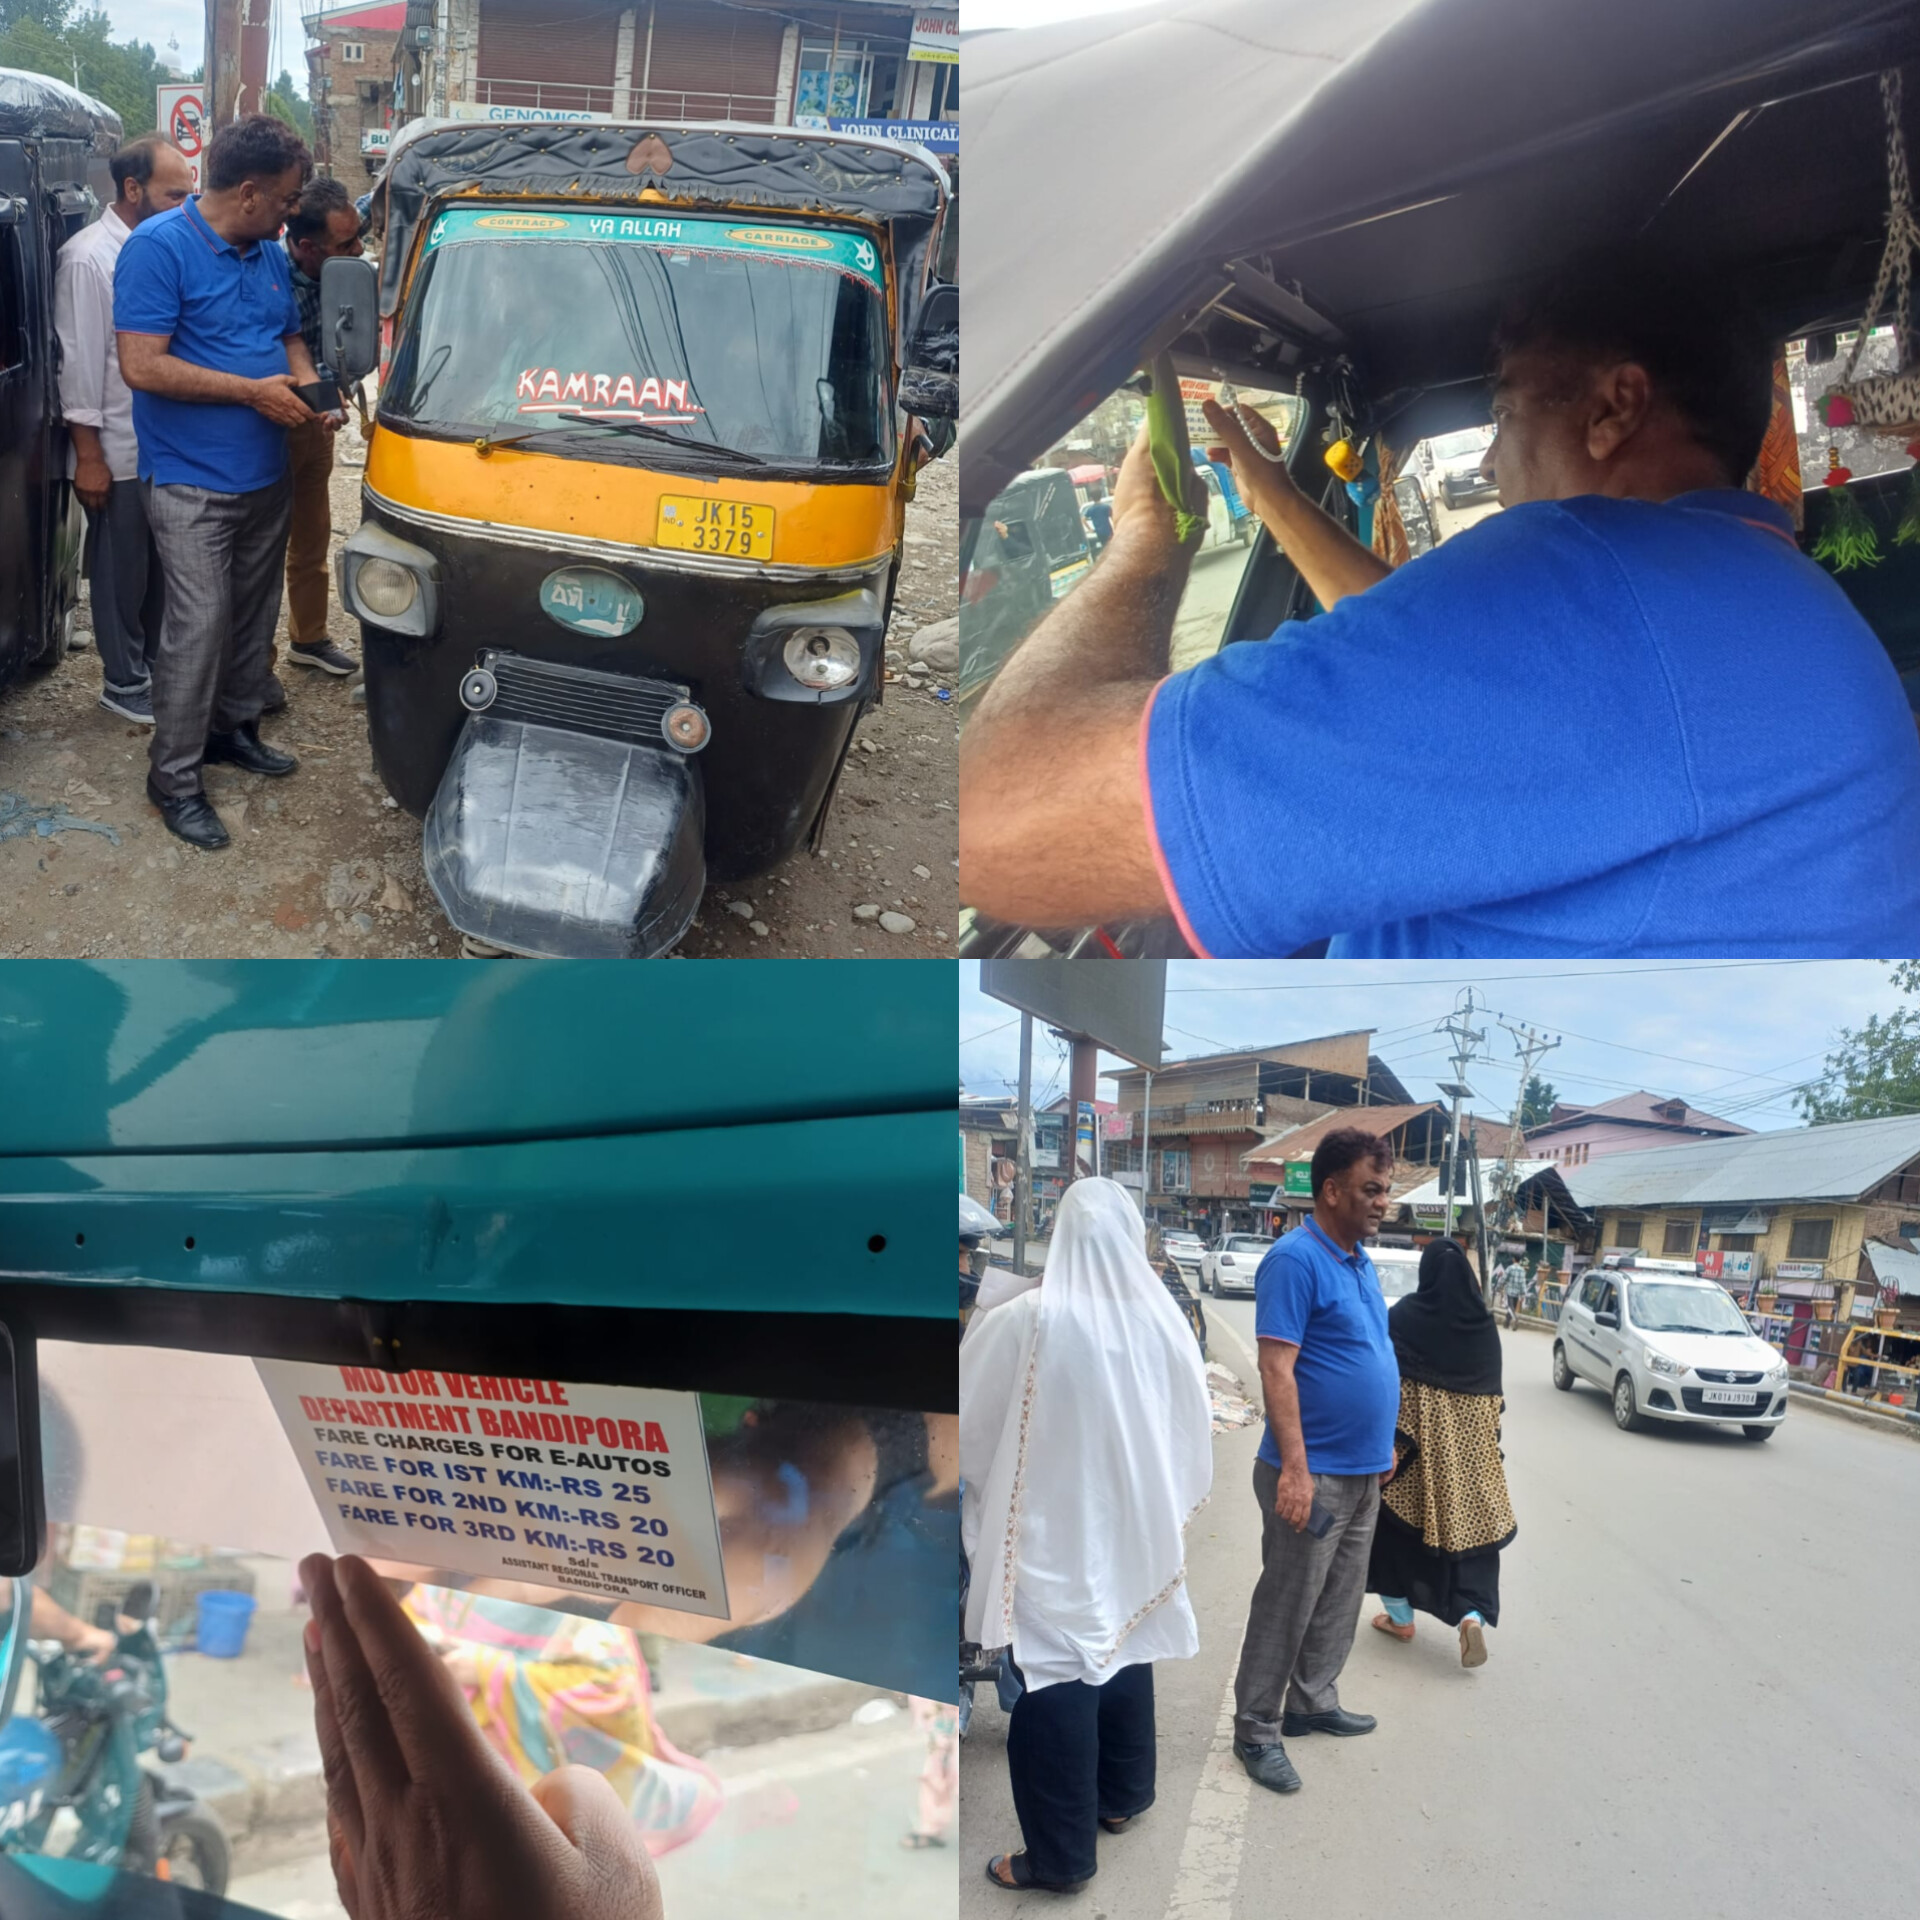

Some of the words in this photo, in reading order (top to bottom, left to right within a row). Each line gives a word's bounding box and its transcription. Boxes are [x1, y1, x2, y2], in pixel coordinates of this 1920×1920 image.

[915, 17, 944, 34] JOHN
[840, 124, 882, 137] JOHN
[886, 125, 959, 141] CLINICAL
[489, 218, 555, 227] CONTRACT
[589, 219, 615, 234] YA
[620, 219, 682, 238] ALLAH
[744, 232, 819, 246] CARRIAGE
[695, 501, 753, 529] JK15
[693, 526, 752, 555] 3379
[442, 1371, 569, 1406] VEHICLE
[299, 1395, 473, 1435] DEPARTMENT
[476, 1407, 671, 1454] BANDIPORA
[313, 1427, 370, 1445] FARE
[373, 1432, 484, 1458] CHARGES
[490, 1443, 544, 1464] FOR
[548, 1449, 672, 1477] E-AUTOS
[315, 1450, 379, 1471] FARE
[383, 1456, 439, 1479] FOR
[496, 1468, 603, 1498] KM:-RS
[611, 1482, 652, 1504] 25
[325, 1477, 388, 1499] FARE
[392, 1484, 447, 1507] FOR
[452, 1492, 507, 1514] 2ND
[515, 1500, 621, 1530] KM:-RS
[629, 1515, 669, 1537] 20
[338, 1504, 399, 1526] FARE
[404, 1511, 458, 1535] FOR
[462, 1519, 516, 1541] 3RD
[524, 1529, 628, 1560] KM:-RS
[636, 1546, 675, 1568] 20
[502, 1556, 549, 1572] ASSISTANT
[551, 1564, 599, 1580] REGIONAL
[600, 1572, 659, 1592] TRANSPORT
[661, 1583, 707, 1600] OFFICER
[557, 1575, 631, 1595] BANDIPORA
